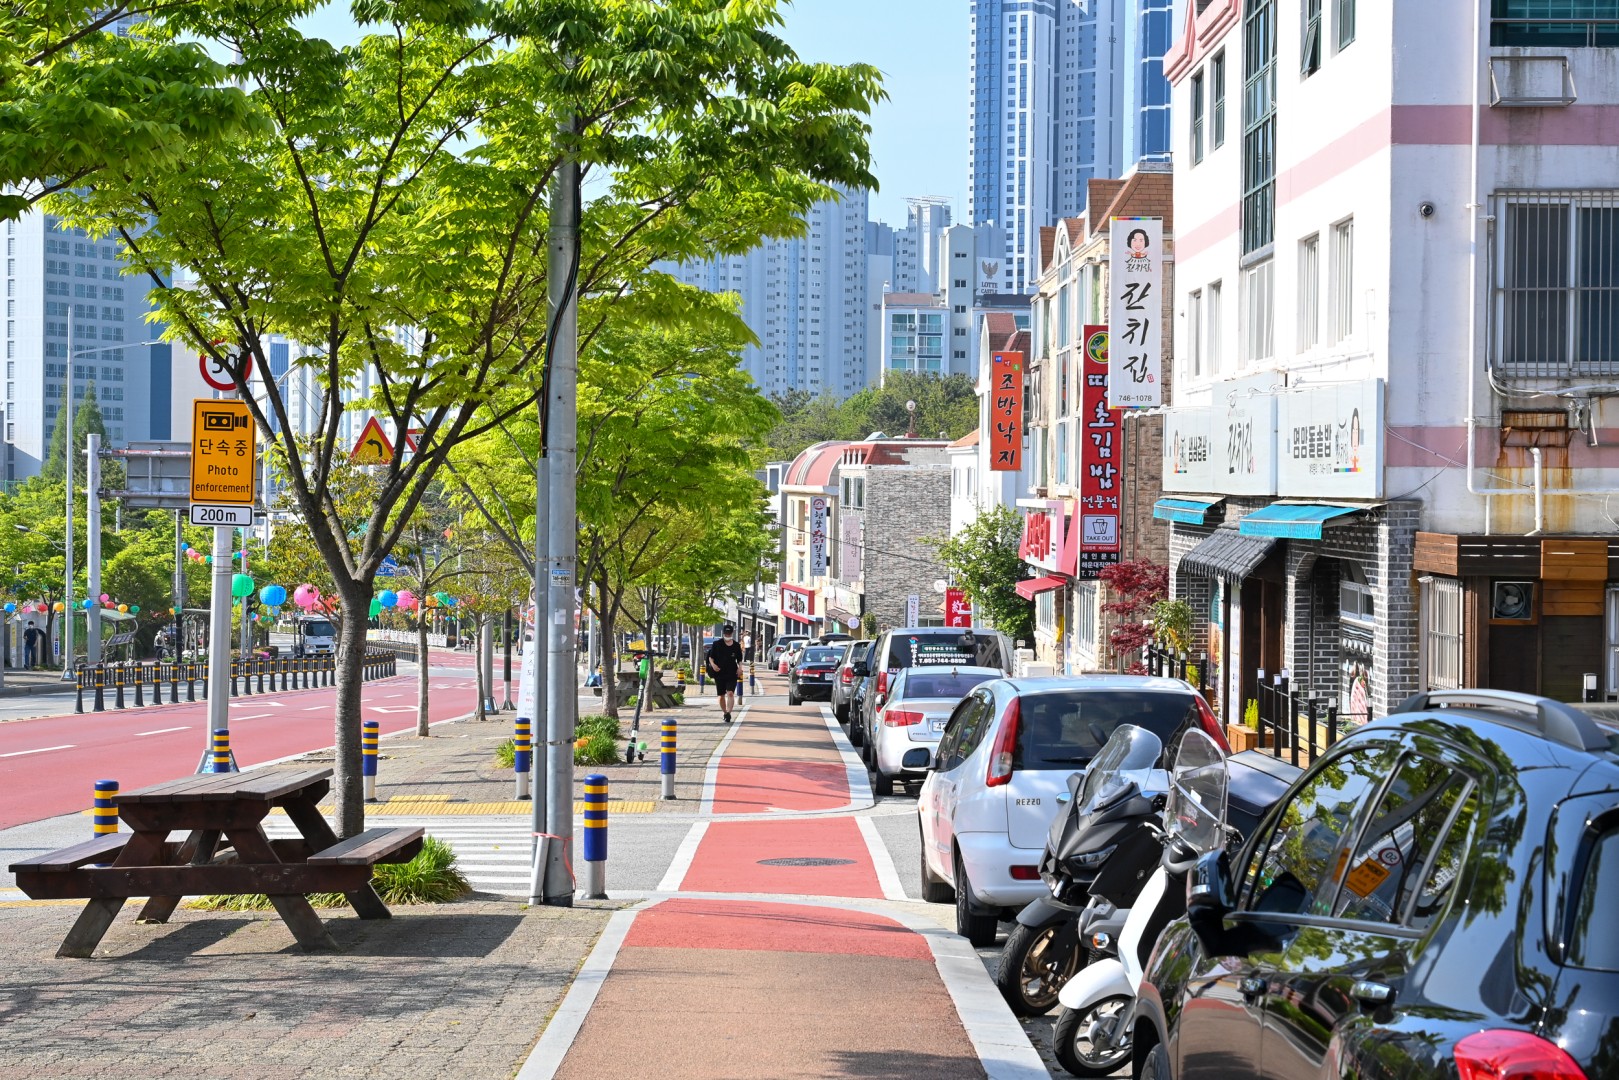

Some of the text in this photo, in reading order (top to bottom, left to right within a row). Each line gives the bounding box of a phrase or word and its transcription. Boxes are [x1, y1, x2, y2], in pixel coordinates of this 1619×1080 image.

[1120, 282, 1152, 383] 잔치집
[1118, 394, 1153, 402] 746-1078
[997, 373, 1017, 466] 조방낙지
[199, 438, 248, 457] 단속중
[1293, 423, 1332, 459] 영양돌솥밥
[207, 464, 239, 476] Photo
[195, 482, 250, 493] enforcement
[1082, 494, 1118, 509] 전문점
[1015, 798, 1041, 806] REZZO
